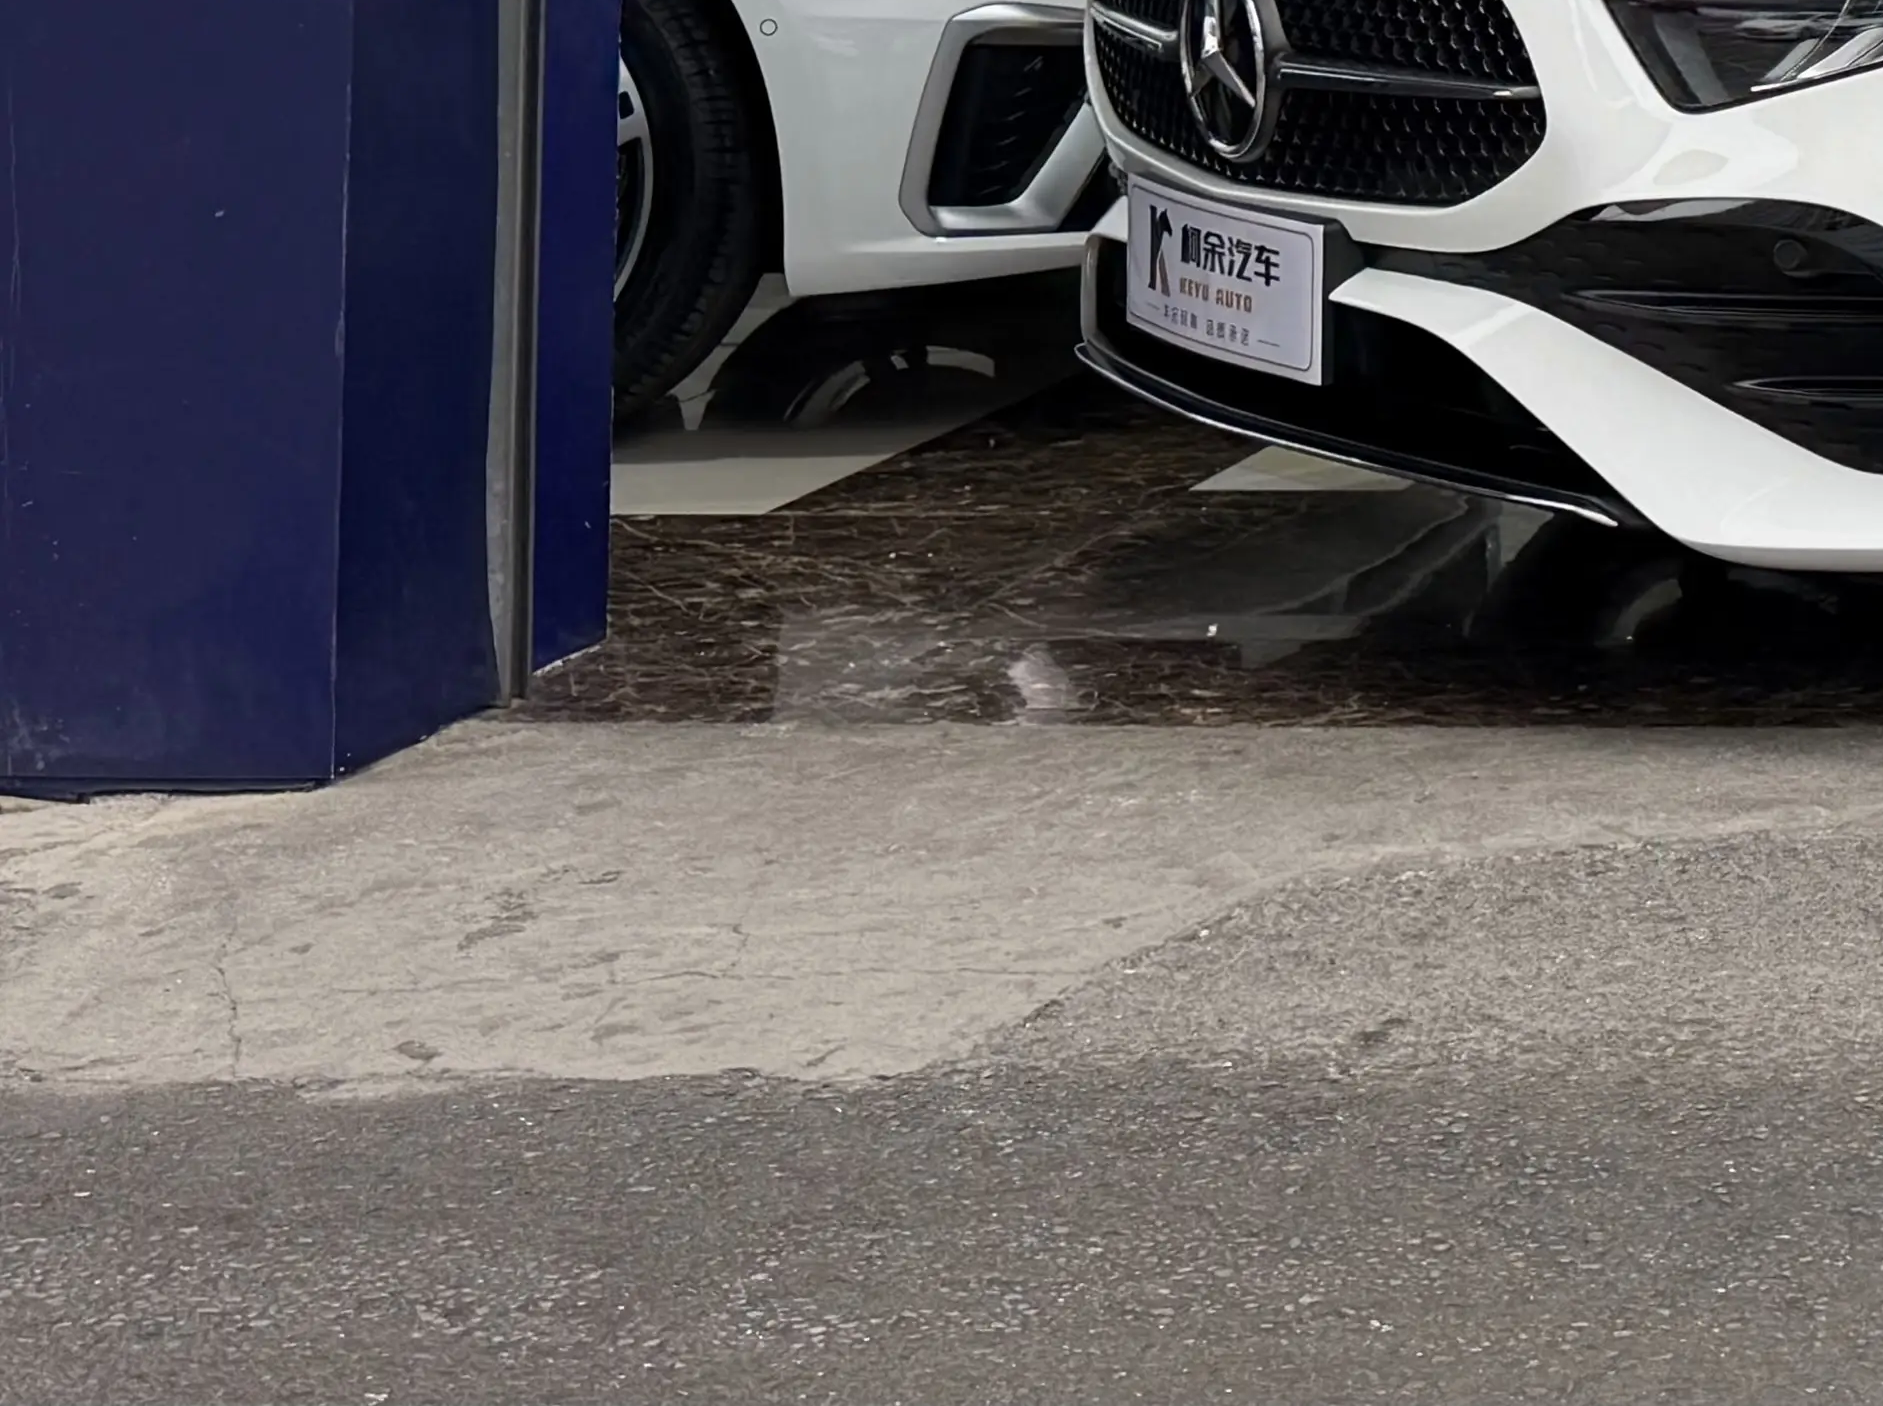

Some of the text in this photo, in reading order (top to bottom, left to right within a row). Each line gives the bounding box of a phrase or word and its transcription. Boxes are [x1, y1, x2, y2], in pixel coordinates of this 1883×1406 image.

[1180, 223, 1281, 287] 柯余汽车
[1215, 289, 1253, 314] AUTO
